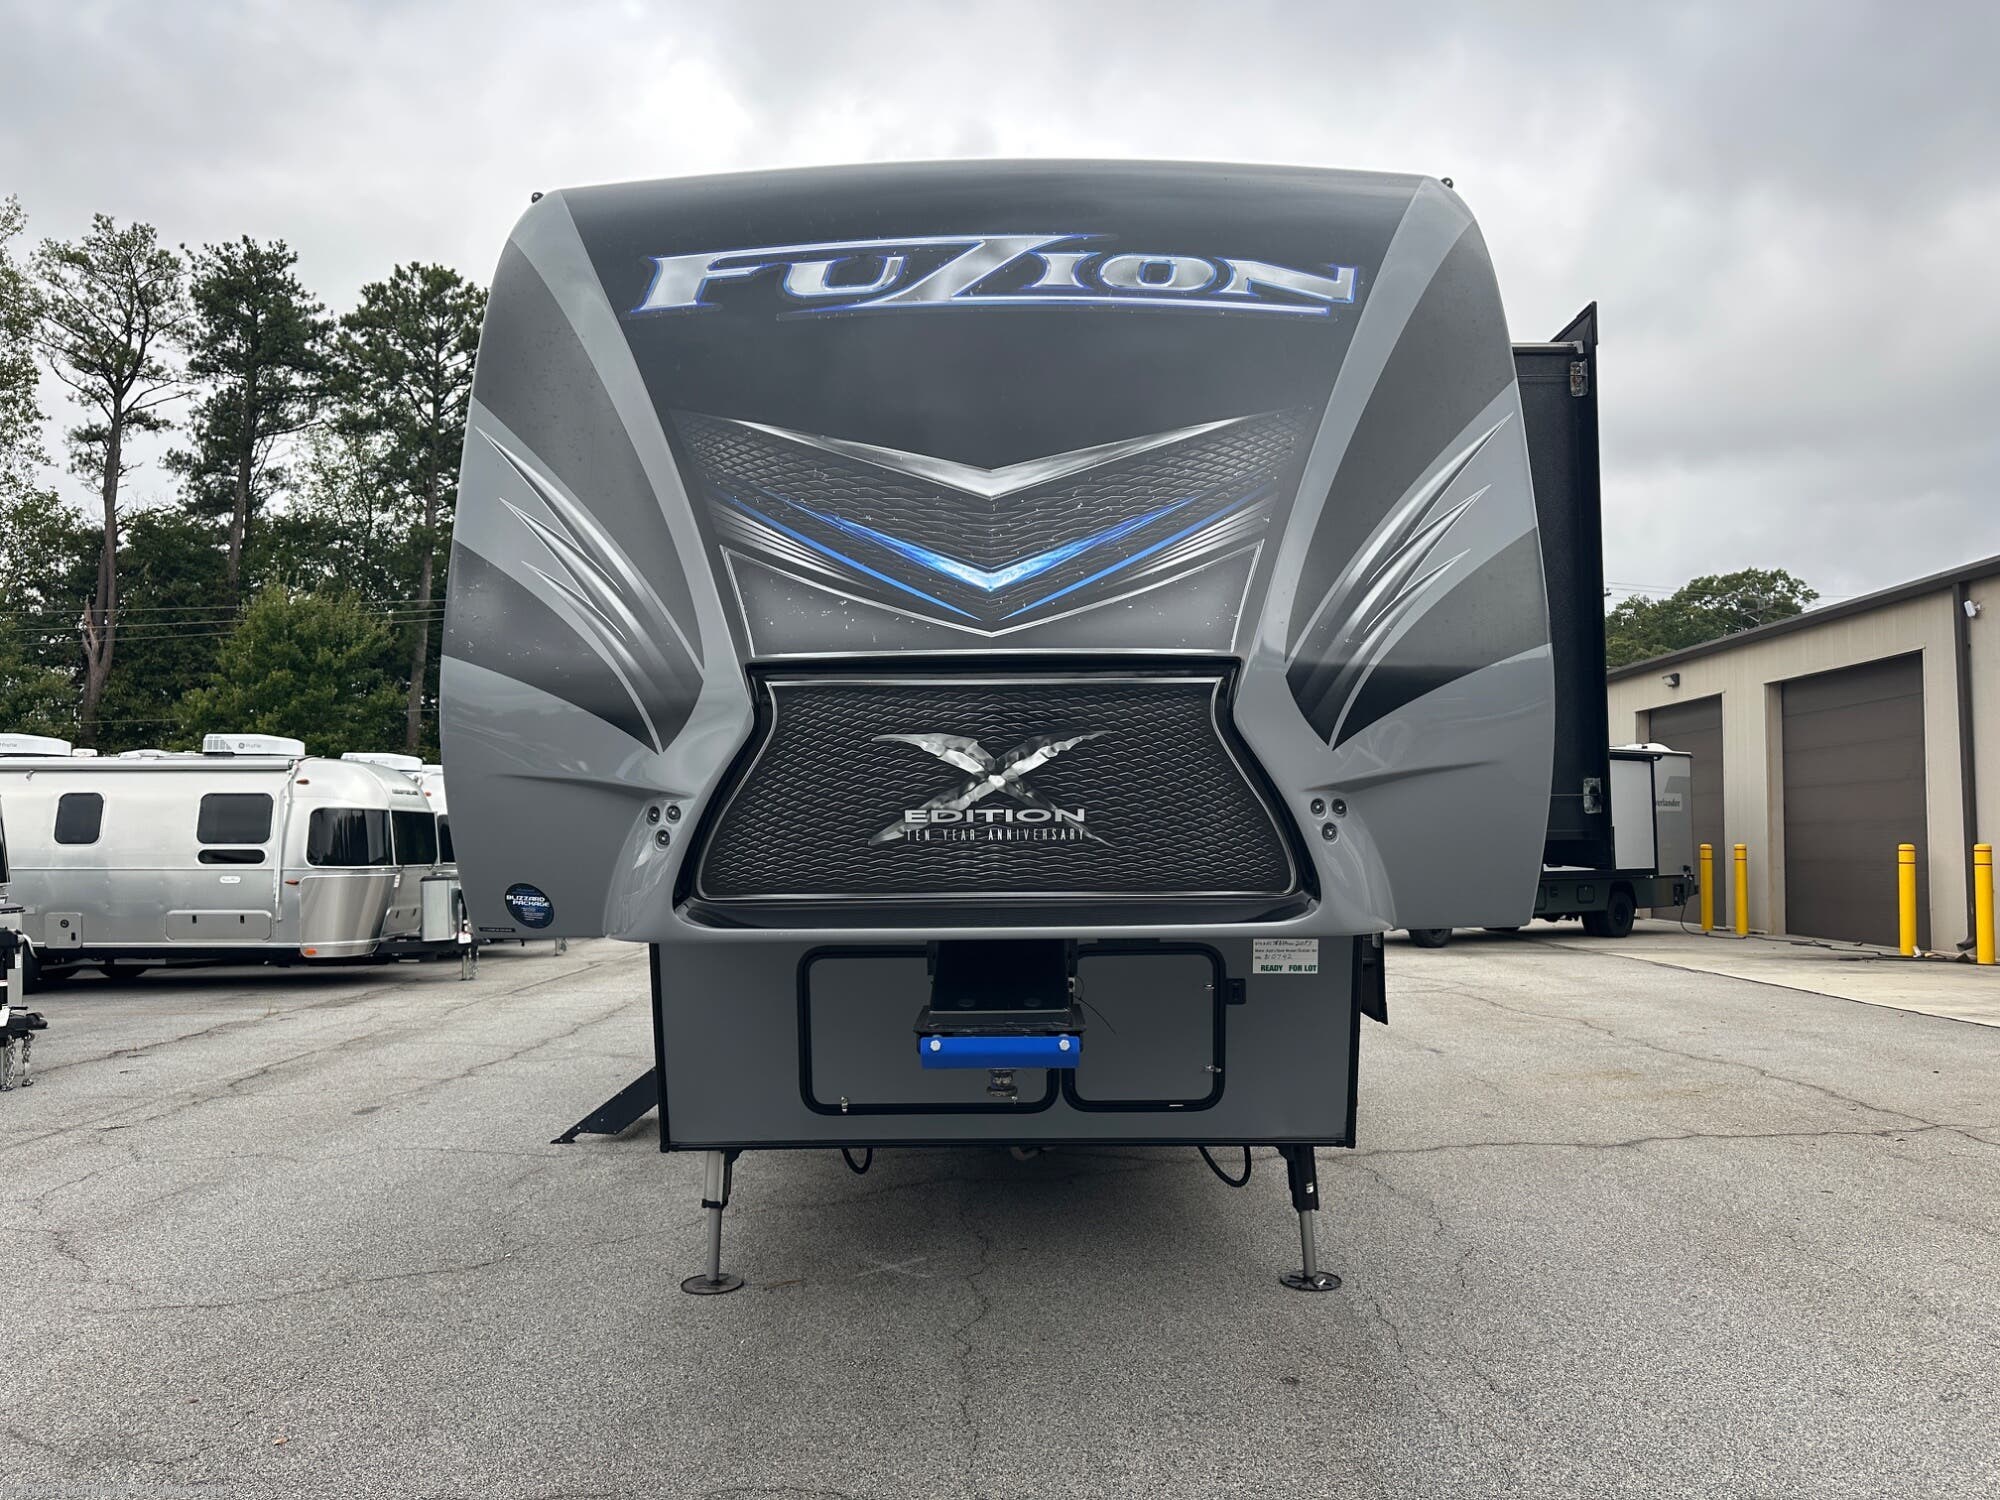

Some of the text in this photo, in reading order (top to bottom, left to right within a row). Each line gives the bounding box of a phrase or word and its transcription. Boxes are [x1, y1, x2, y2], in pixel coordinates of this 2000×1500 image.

[633, 234, 1356, 314] FUZION
[904, 808, 1085, 823] EDITION
[906, 829, 1085, 841] TEN YEAR ANNIVERSARY
[1260, 964, 1317, 972] READY FOR LOT
